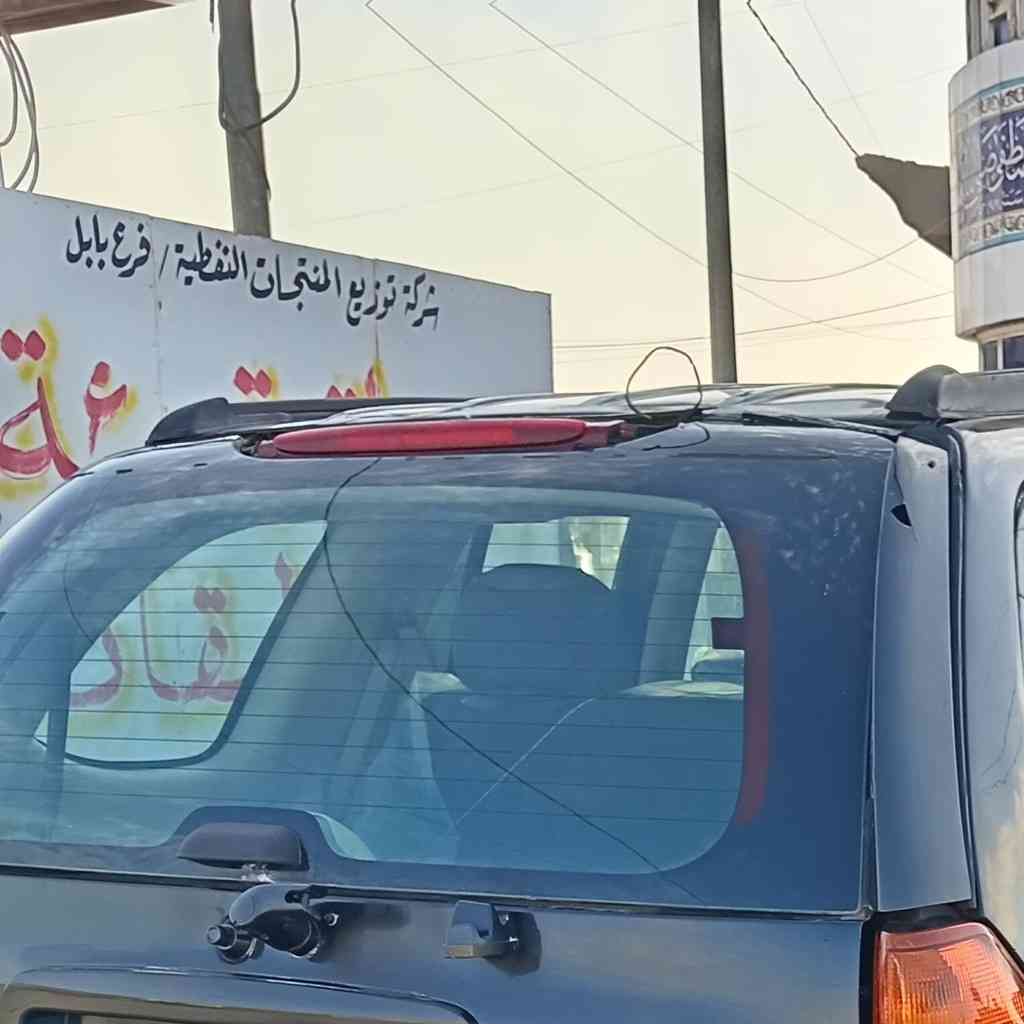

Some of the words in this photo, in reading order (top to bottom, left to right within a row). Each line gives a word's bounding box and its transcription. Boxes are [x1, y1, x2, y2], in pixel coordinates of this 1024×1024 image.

[65, 213, 109, 271] بابل
[111, 220, 153, 278] فرع
[174, 231, 249, 286] النفطية
[345, 274, 397, 327] توزيع
[403, 271, 441, 331] شركة
